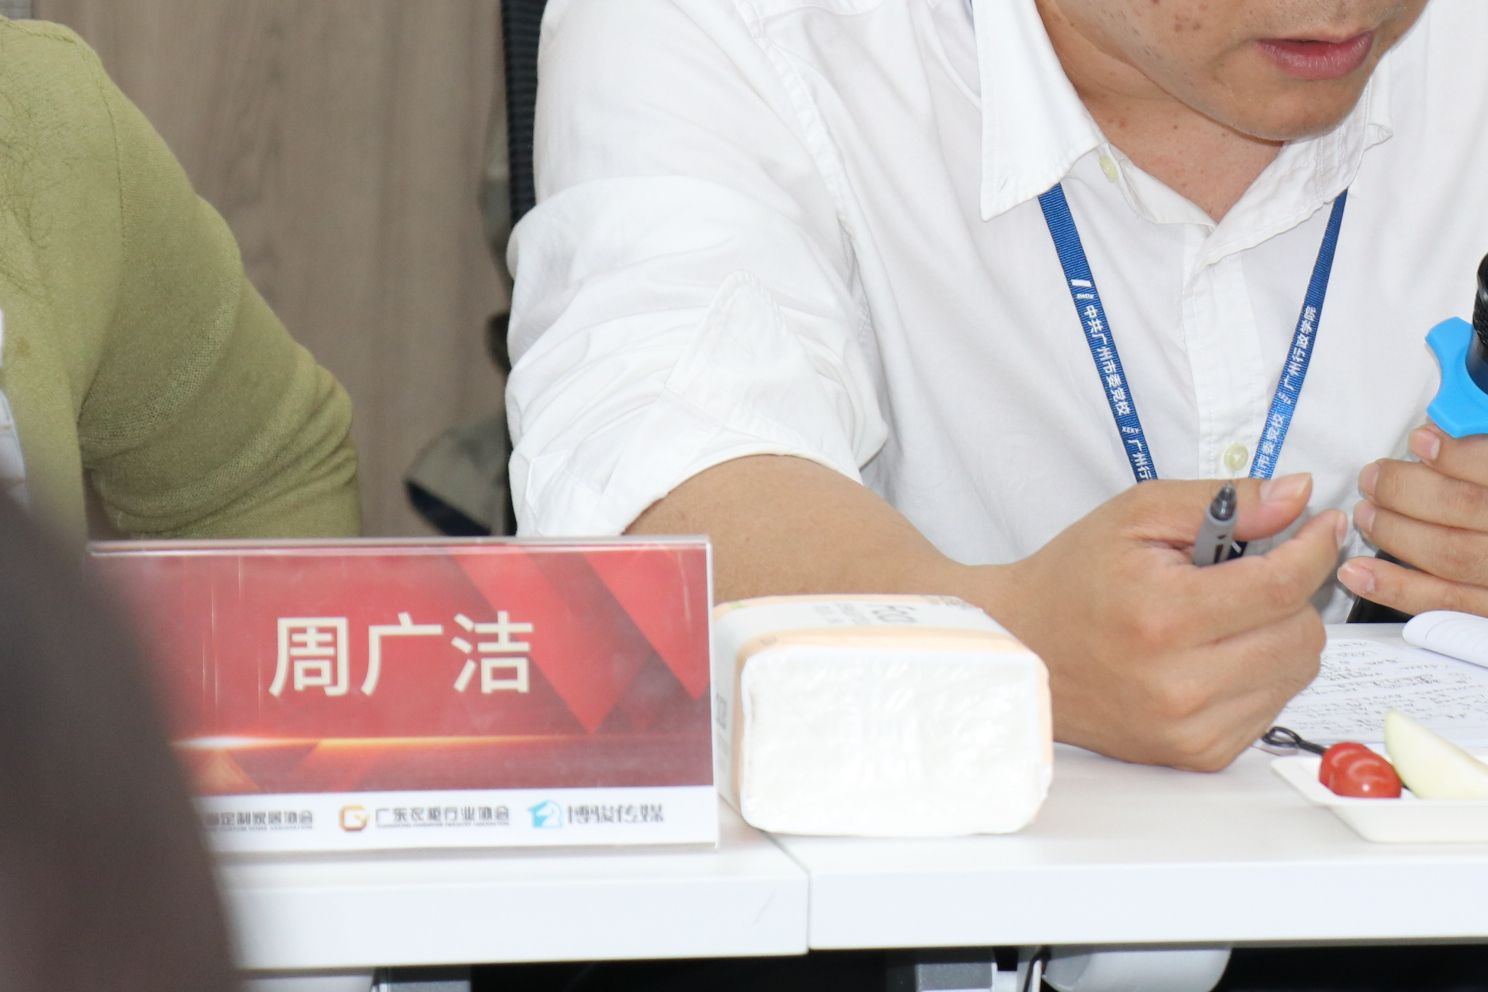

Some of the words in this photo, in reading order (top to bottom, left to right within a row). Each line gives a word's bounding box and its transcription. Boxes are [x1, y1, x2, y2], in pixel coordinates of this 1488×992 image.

[1083, 304, 1131, 416] 中共广州市委党校
[1284, 305, 1317, 391] 广州行政学院
[269, 611, 534, 698] 周广洁
